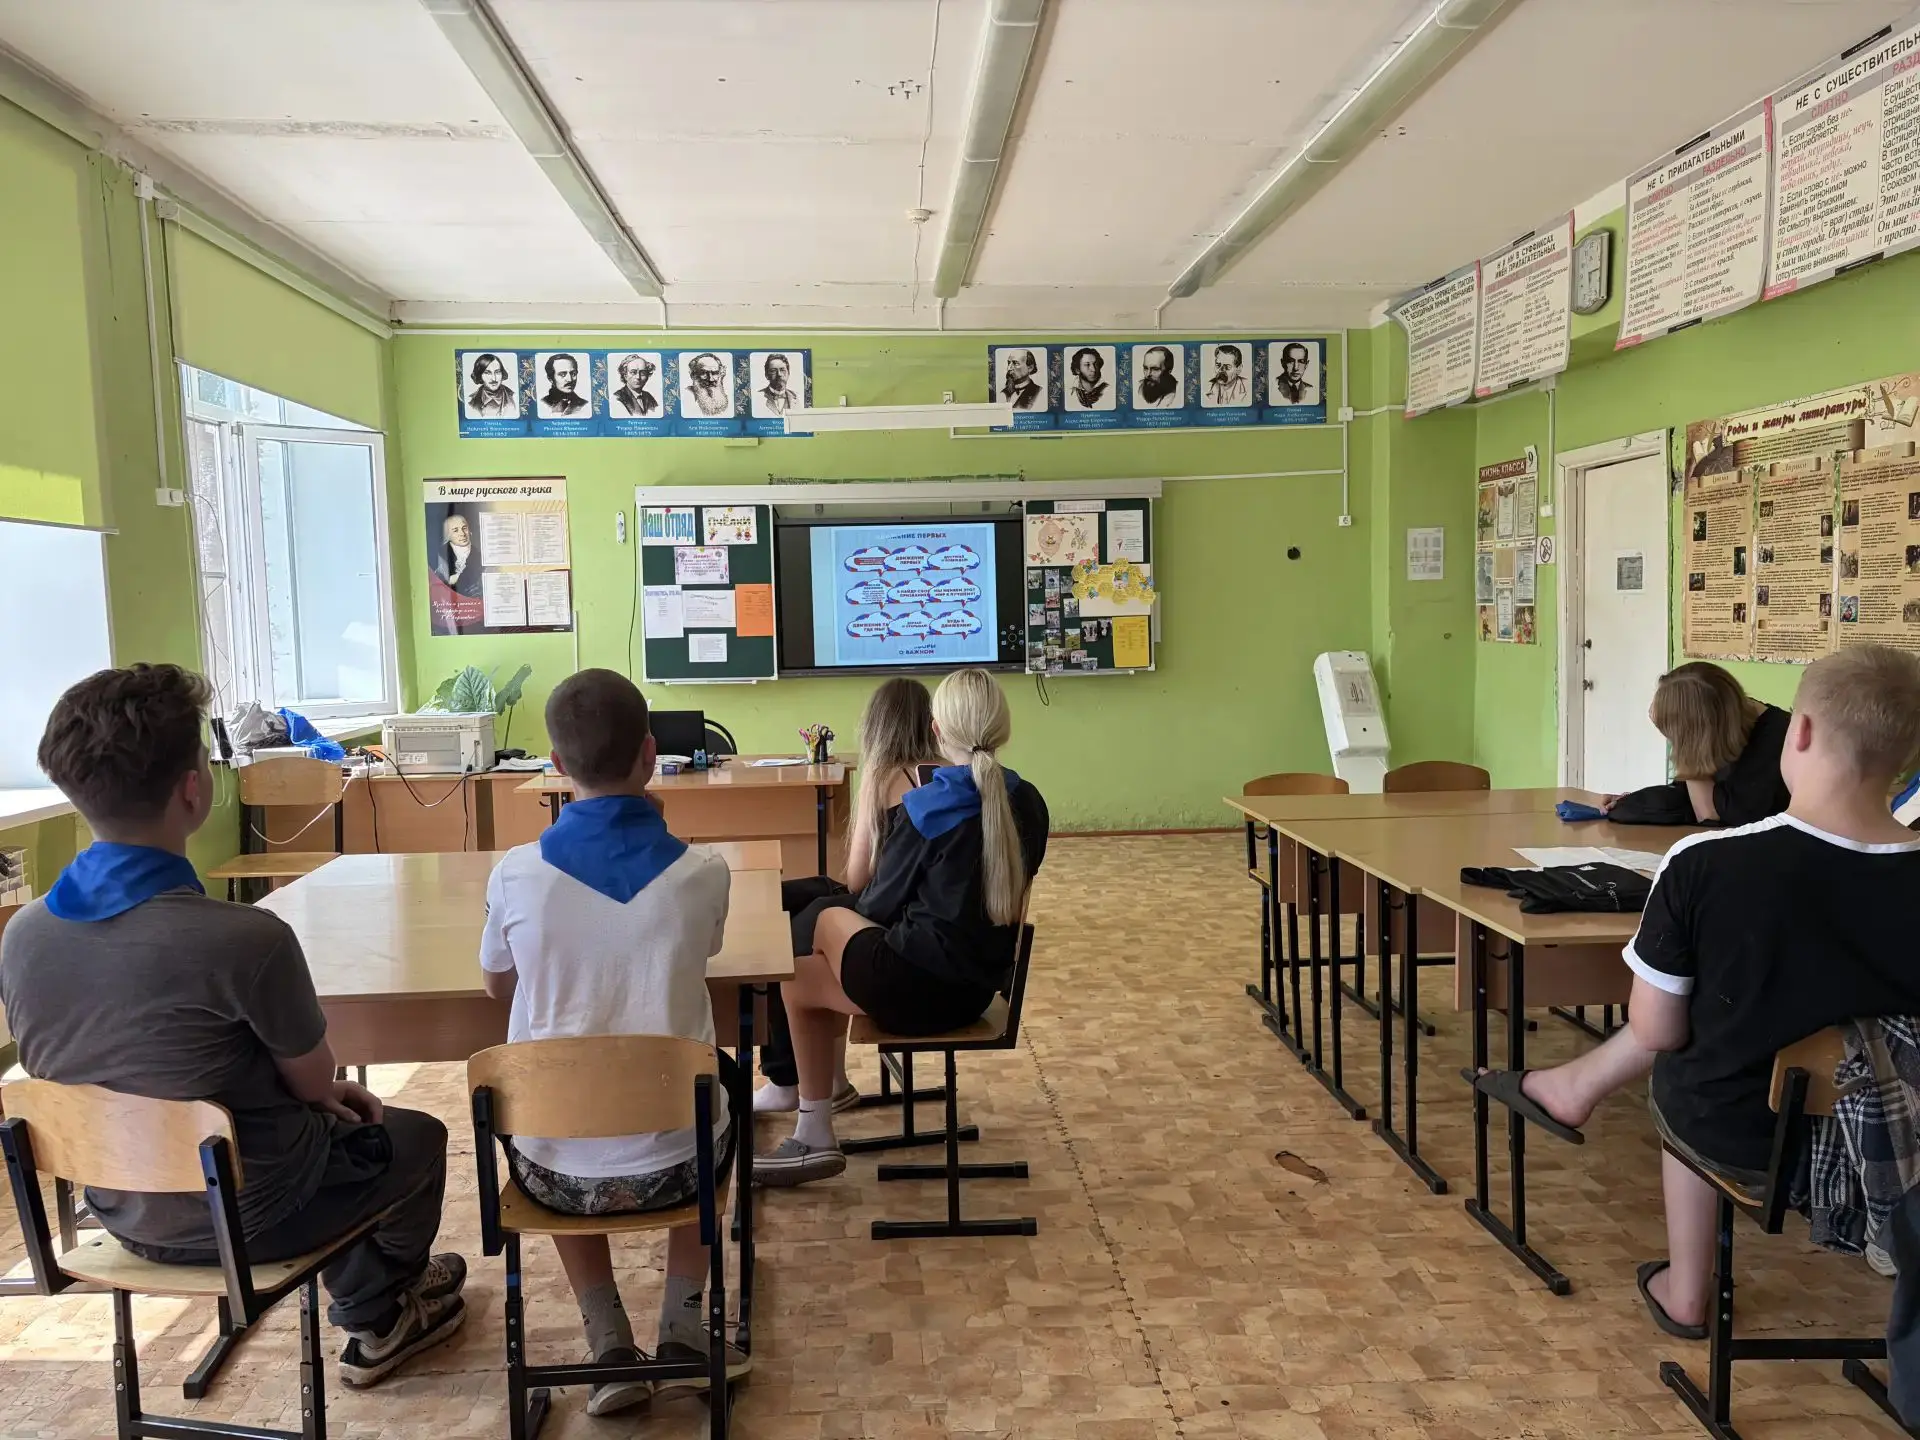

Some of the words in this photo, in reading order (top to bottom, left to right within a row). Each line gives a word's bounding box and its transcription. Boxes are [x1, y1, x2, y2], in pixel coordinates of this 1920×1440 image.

[1884, 77, 1903, 95] Если
[1796, 93, 1808, 110] НЕ
[1815, 87, 1820, 99] С
[1811, 90, 1848, 118] СЛИТНО
[1883, 98, 1888, 106] с
[1883, 93, 1919, 117] является
[1789, 129, 1804, 145] Если
[1806, 121, 1825, 136] слово
[1826, 111, 1838, 126] без
[1647, 178, 1655, 191] НЕ
[1659, 174, 1664, 183] С
[1668, 128, 1745, 179] ПРИЛАГАТЕЛЬНЫМИ
[1703, 144, 1746, 176] РАЗДЕЛЬНО
[1781, 150, 1788, 158] не
[1881, 149, 1887, 160] В
[1890, 142, 1909, 156] таких
[1881, 156, 1902, 171] часто
[1786, 187, 1802, 202] Если
[1803, 180, 1823, 194] слово
[1824, 177, 1828, 185] с
[1844, 160, 1866, 176] можно
[1880, 185, 1884, 193] с
[1887, 172, 1916, 190] союзом
[1780, 197, 1808, 214] заменить
[1809, 179, 1847, 201] синонимом
[1879, 190, 1898, 207] Это
[1778, 213, 1789, 225] без
[1803, 204, 1815, 214] или
[1817, 190, 1844, 208] близким
[1829, 212, 1847, 227] враг)
[1848, 202, 1873, 218] стоял
[1777, 227, 1784, 235] по
[1786, 216, 1810, 233] смыслу
[1782, 245, 1799, 256] стен
[1828, 225, 1839, 238] Он
[1841, 211, 1873, 235] проявил
[1878, 218, 1890, 232] Он
[1892, 214, 1908, 226] мне
[1884, 224, 1916, 245] просто
[1797, 246, 1821, 262] полное
[1727, 423, 1748, 436] Роды
[1752, 422, 1758, 431] и
[1762, 414, 1795, 429] жанры
[1799, 398, 1867, 421] литературы
[1480, 466, 1500, 478] ЖИЗНЬ
[1501, 461, 1525, 474] КЛАССА
[1528, 451, 1534, 467] 9
[438, 486, 446, 496] В
[448, 487, 475, 496] мире
[475, 486, 518, 498] русского
[520, 486, 552, 497] языка
[642, 509, 663, 537] Наш
[665, 512, 694, 541] отряд
